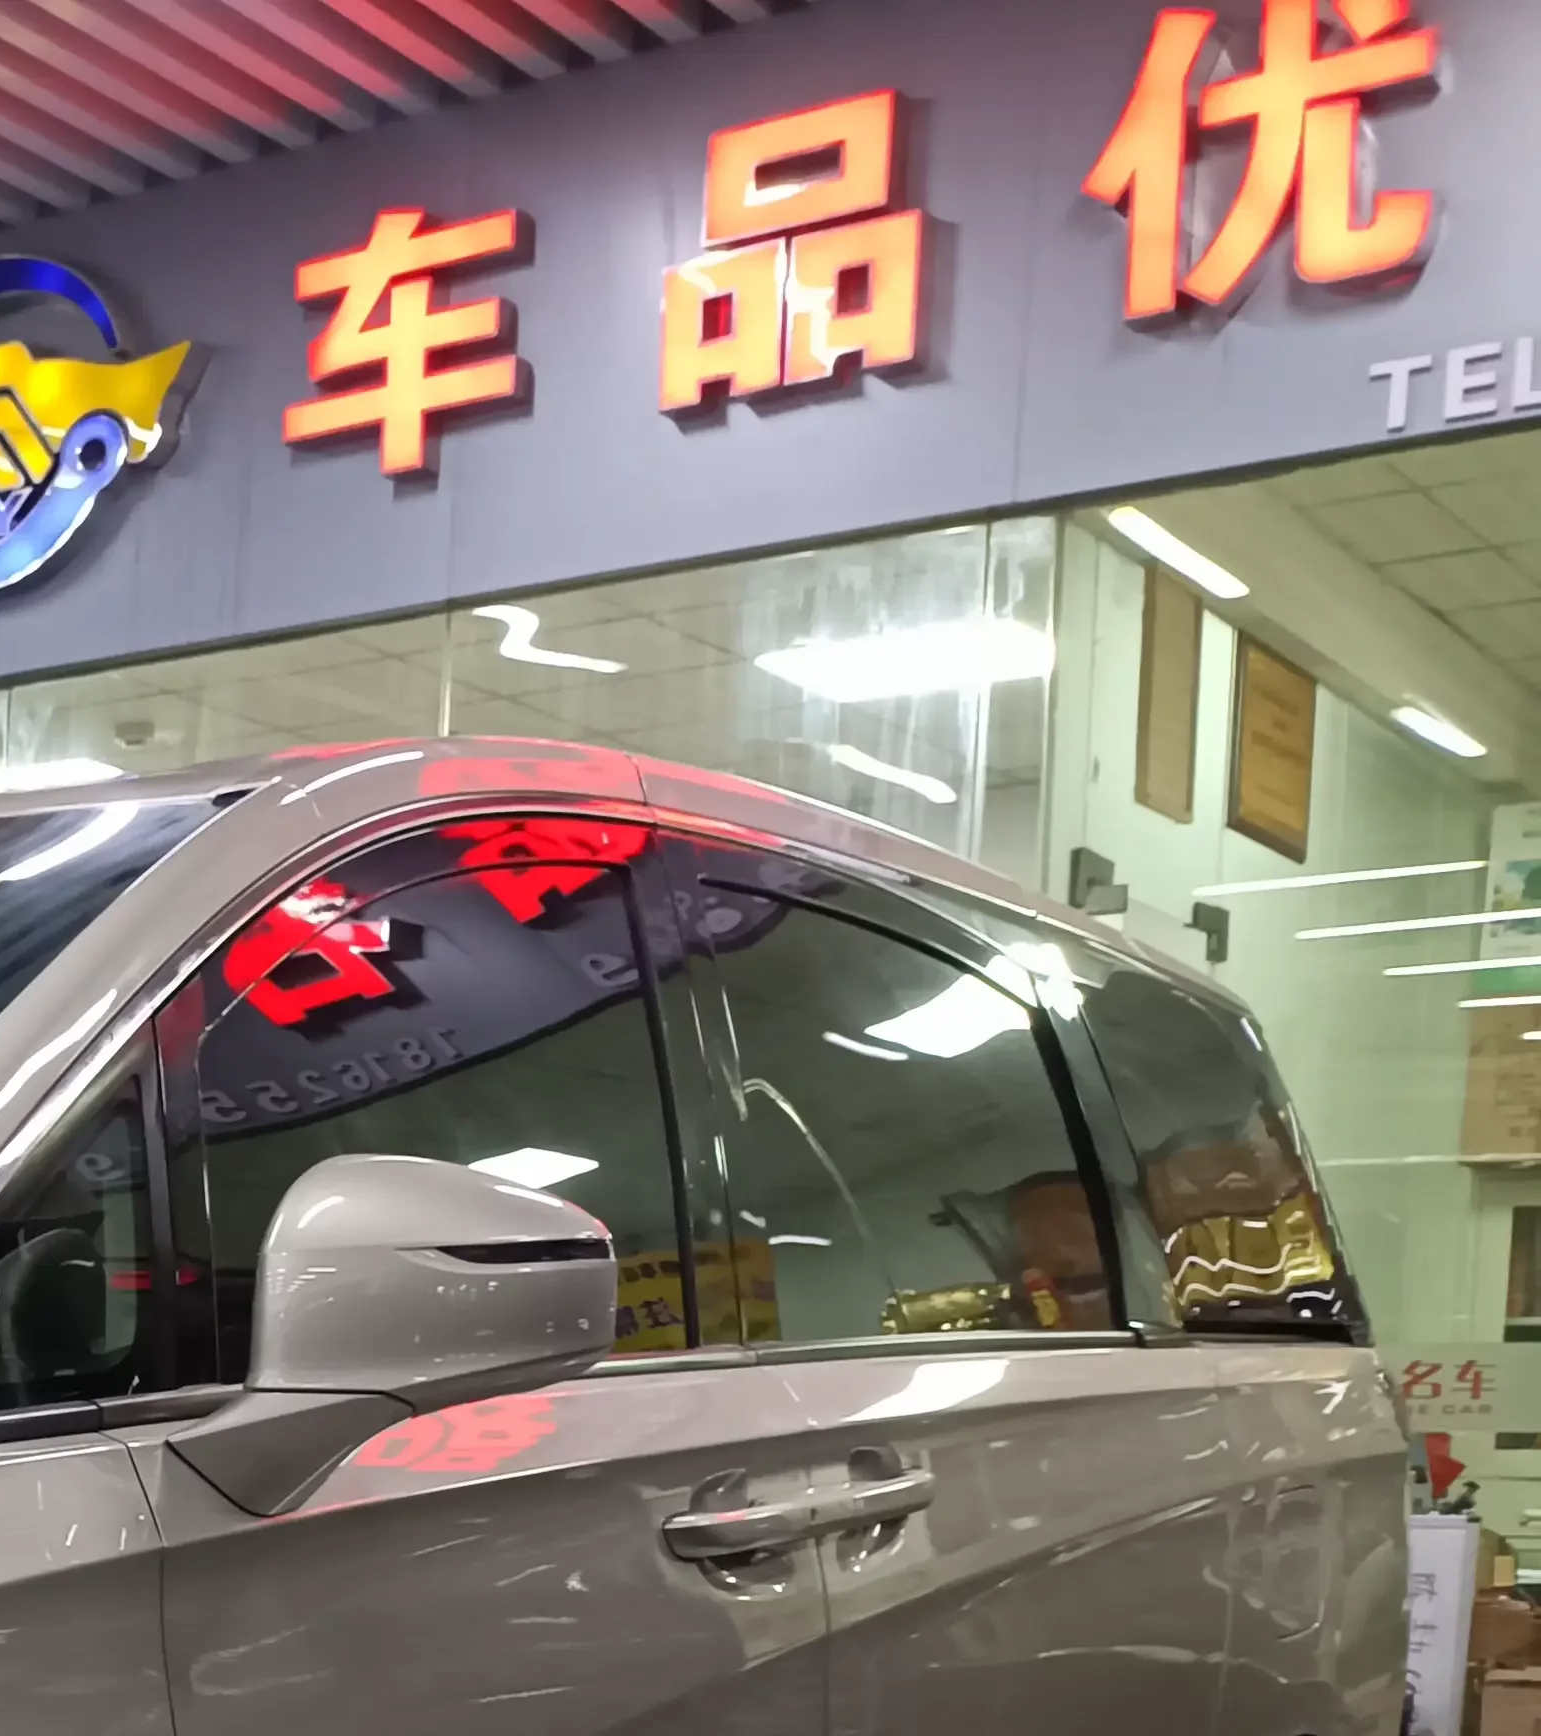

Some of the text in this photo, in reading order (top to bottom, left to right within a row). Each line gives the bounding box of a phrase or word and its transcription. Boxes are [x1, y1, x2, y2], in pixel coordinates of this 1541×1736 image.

[283, 0, 1438, 478] 车品优
[1369, 337, 1541, 434] TEL
[1402, 1360, 1497, 1399] 名车
